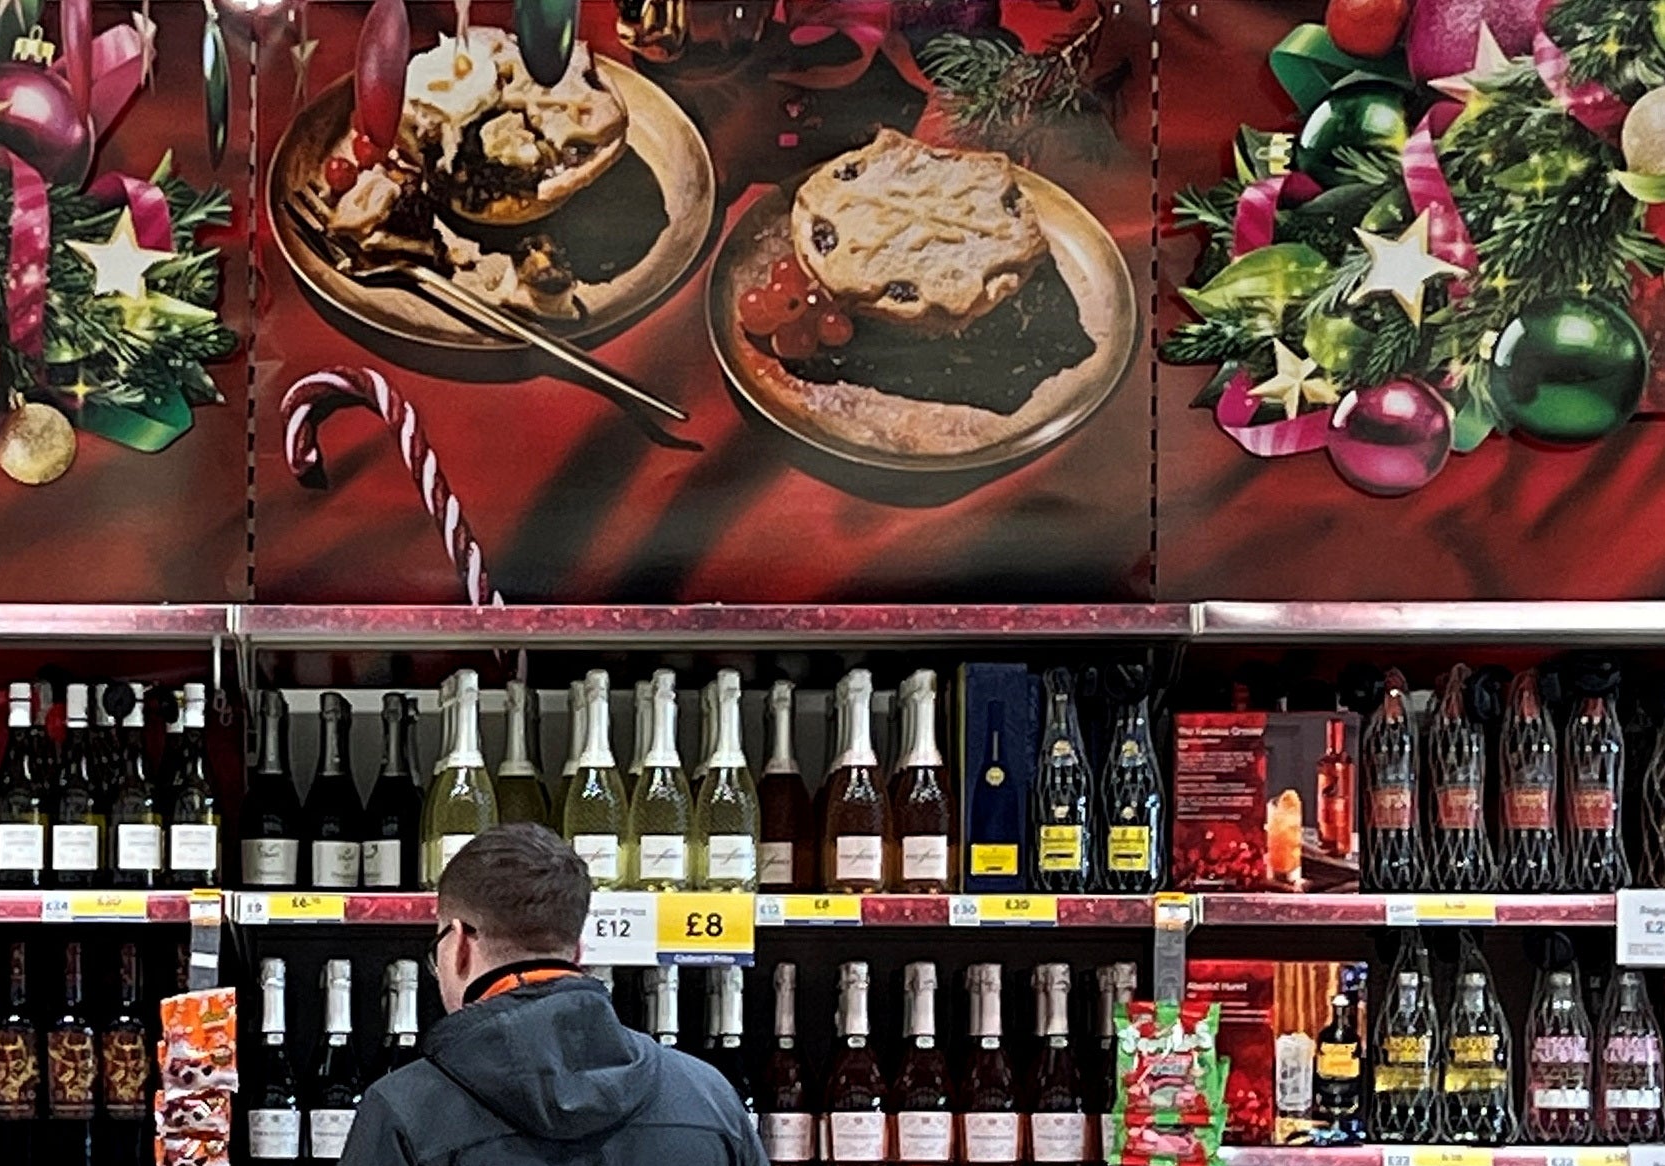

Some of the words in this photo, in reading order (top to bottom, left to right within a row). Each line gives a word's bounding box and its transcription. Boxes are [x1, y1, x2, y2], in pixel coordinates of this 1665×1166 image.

[1004, 899, 1030, 911] £20
[595, 919, 631, 937] £12
[685, 913, 723, 938] £8
